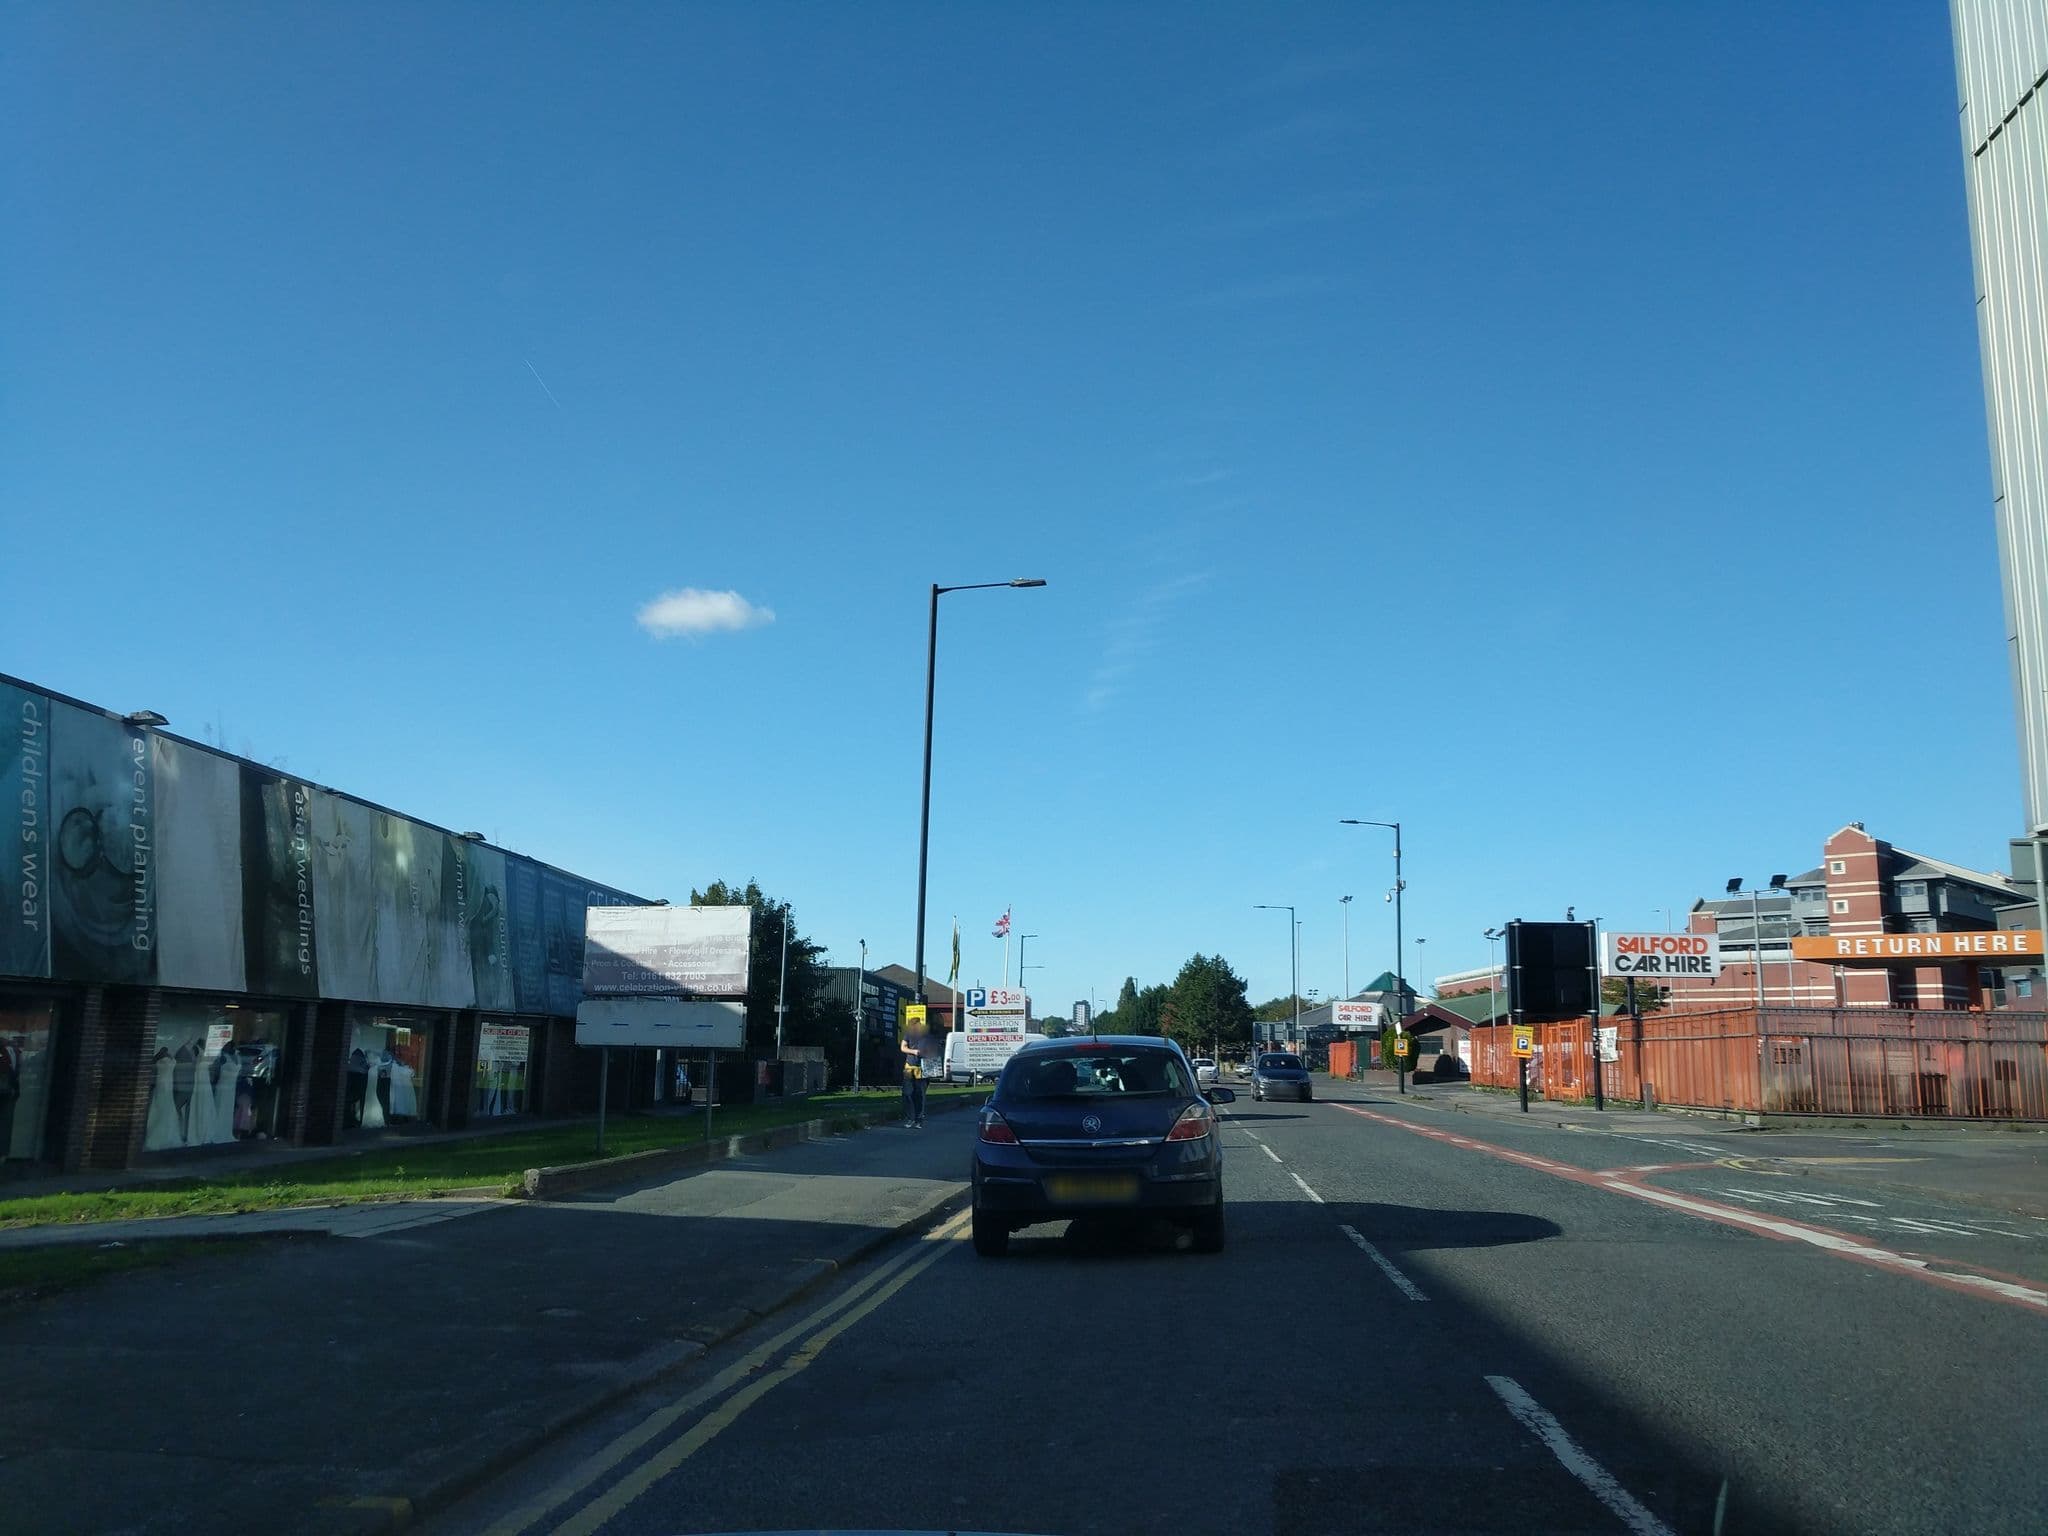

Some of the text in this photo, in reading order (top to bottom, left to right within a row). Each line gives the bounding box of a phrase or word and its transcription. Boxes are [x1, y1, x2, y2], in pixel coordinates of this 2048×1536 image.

[22, 700, 42, 931] childrens wear
[130, 738, 153, 951] event planning
[294, 791, 312, 975] asian weddings
[1617, 936, 1709, 955] SALFORD
[1837, 934, 2029, 955] RETURN HERE
[1615, 955, 1712, 973] CAR HIRE
[640, 972, 662, 980] 0161
[665, 972, 681, 981] 832
[684, 972, 706, 981] 7003
[1338, 1005, 1373, 1013] SALFORD
